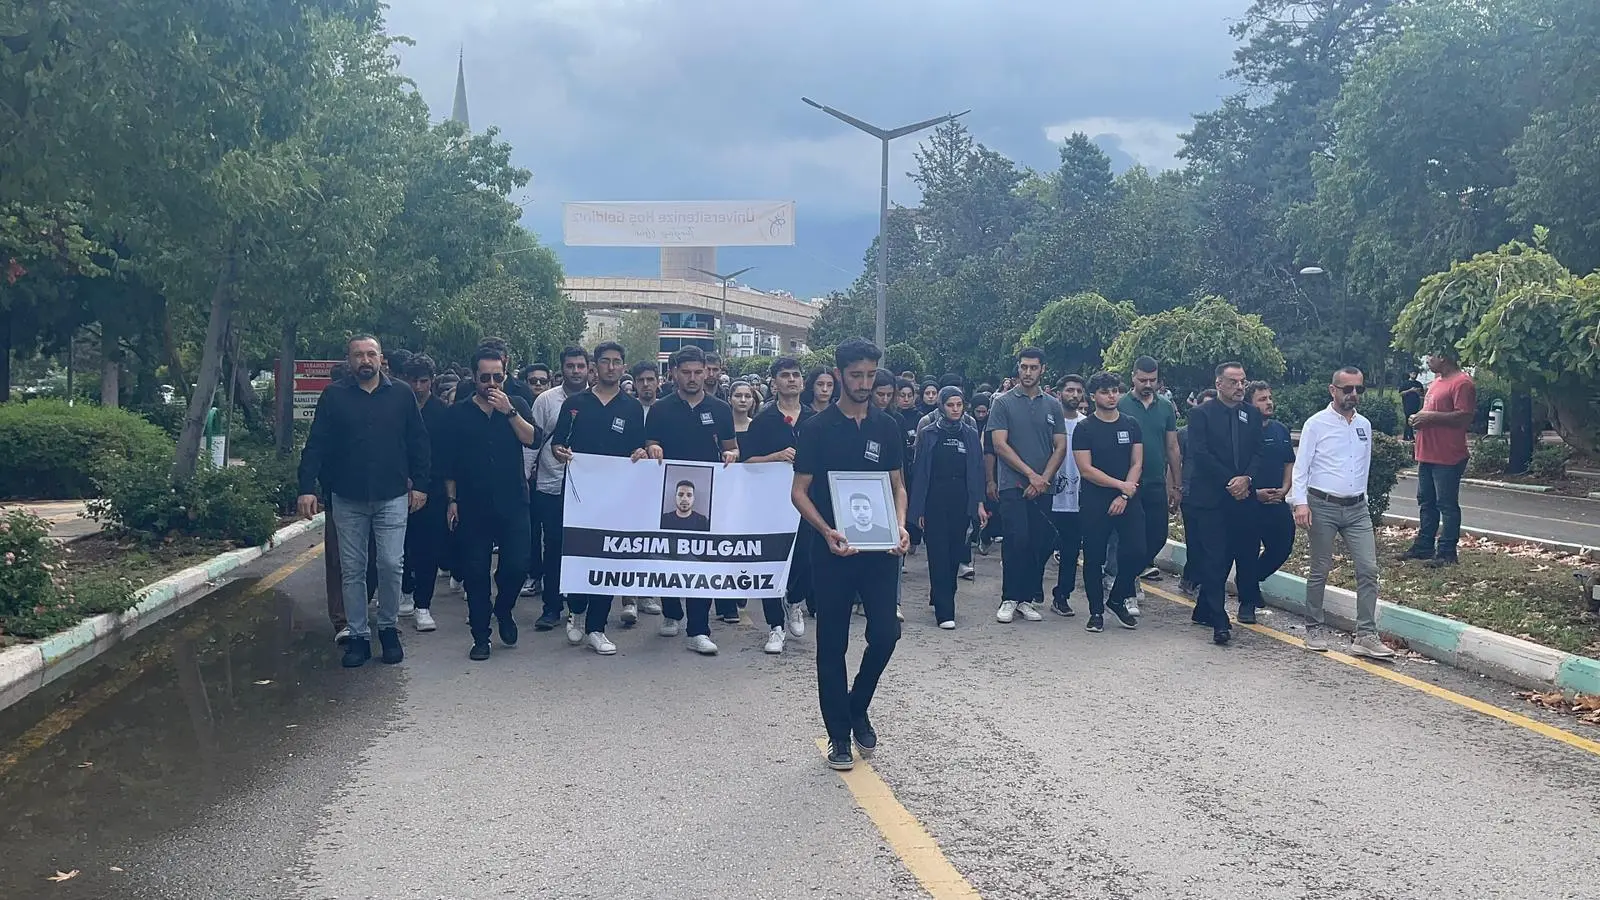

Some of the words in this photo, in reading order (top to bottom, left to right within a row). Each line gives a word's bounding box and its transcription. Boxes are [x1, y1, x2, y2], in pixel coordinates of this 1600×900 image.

[603, 536, 670, 554] KASIM
[677, 538, 762, 556] BULGAN
[588, 570, 774, 590] UNUTMAYACAĞIZ
